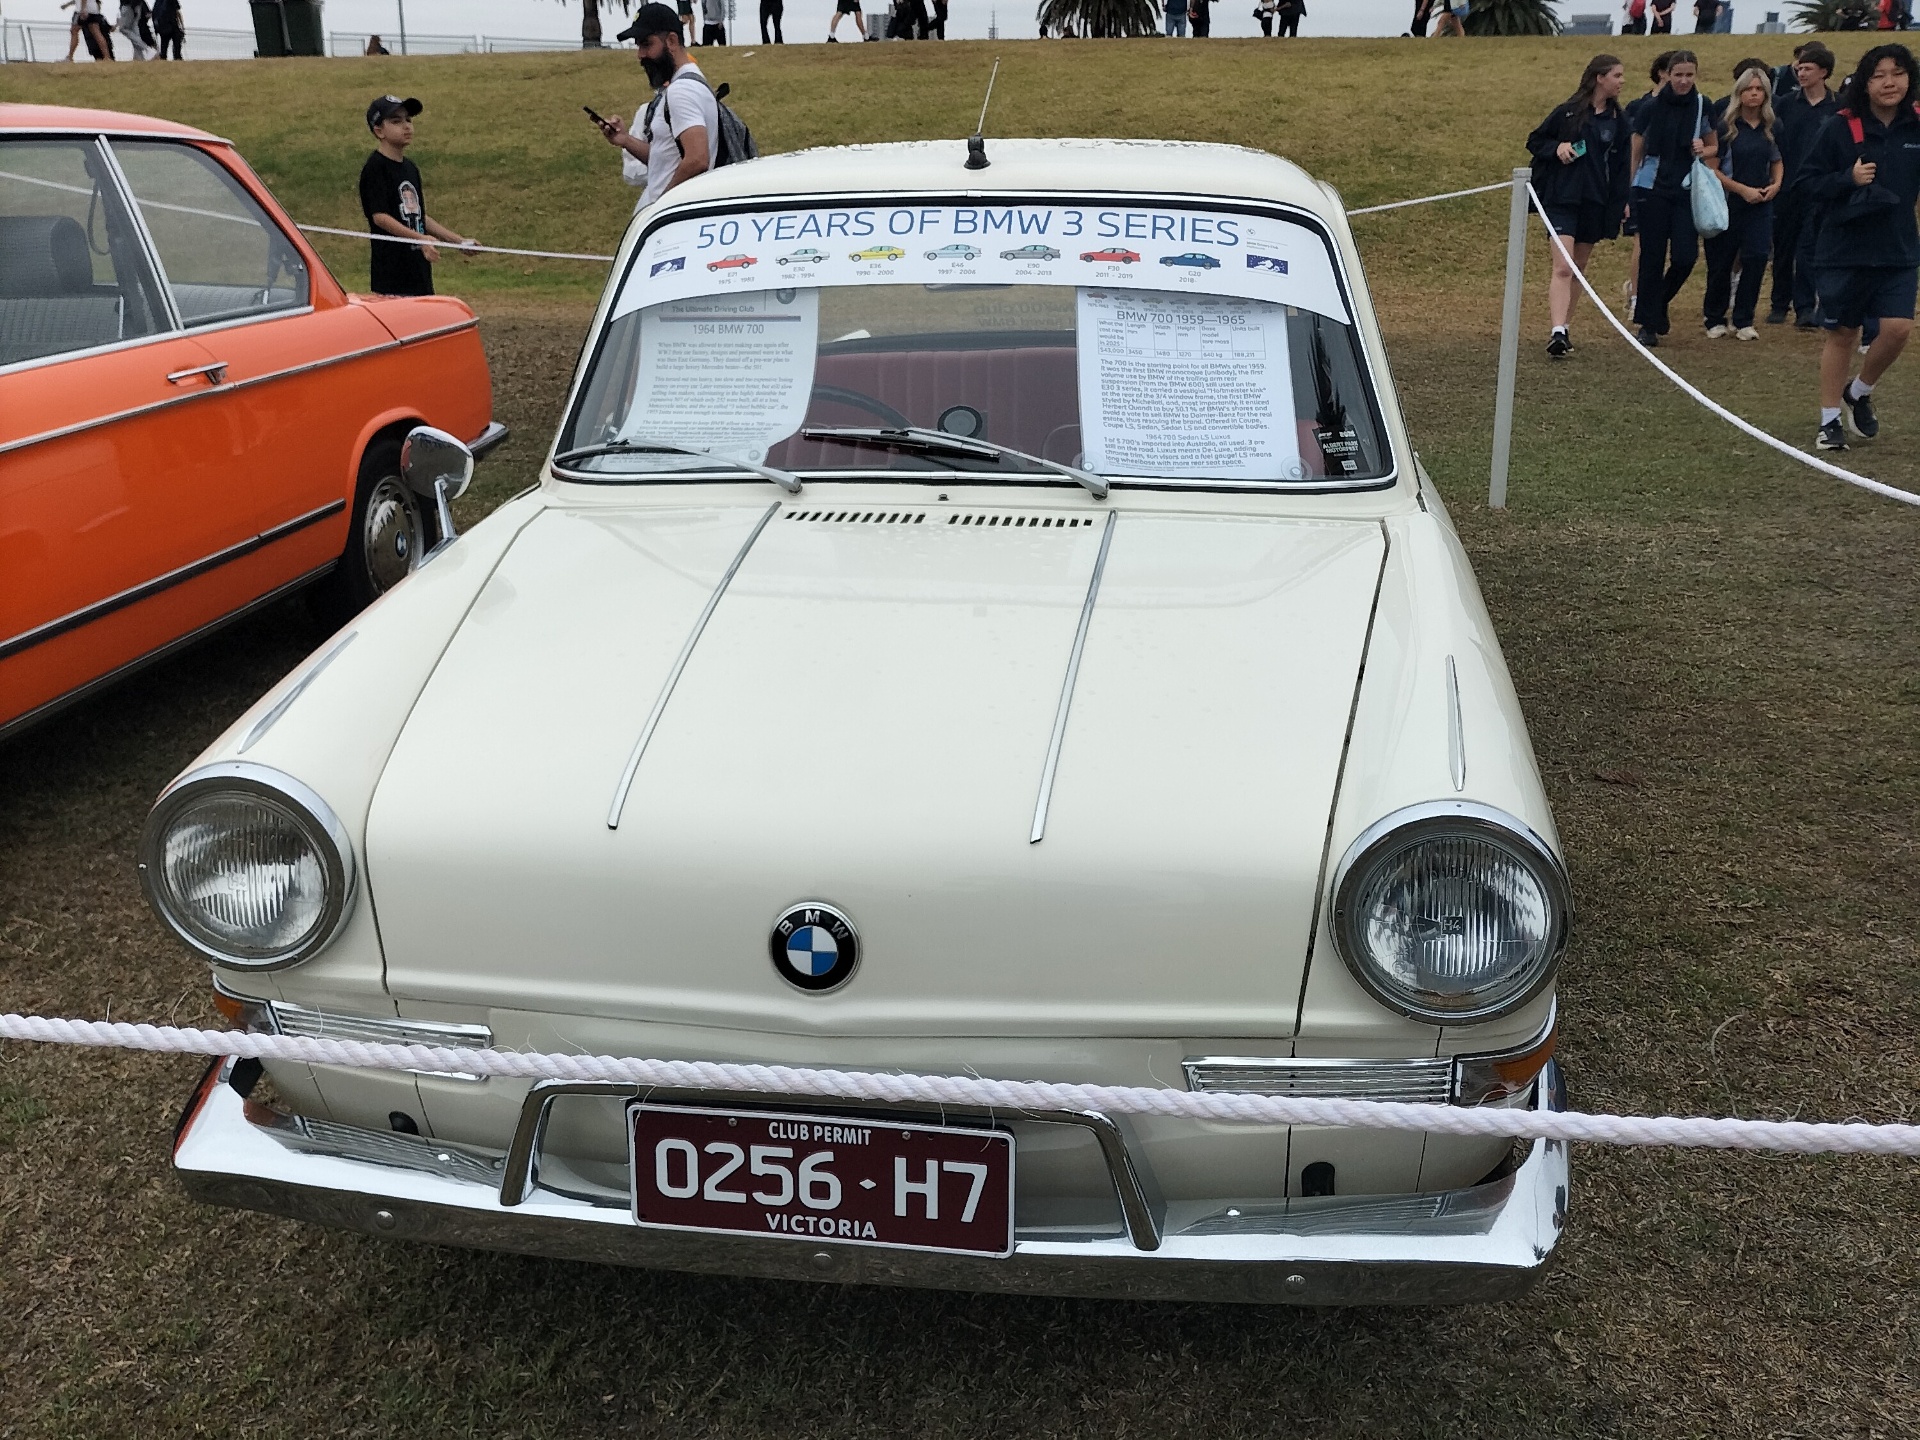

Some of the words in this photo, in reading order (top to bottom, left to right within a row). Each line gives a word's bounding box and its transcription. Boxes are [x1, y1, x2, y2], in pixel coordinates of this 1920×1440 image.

[697, 220, 740, 249] 50
[751, 210, 875, 242] YEARS
[888, 209, 942, 236] OF
[954, 208, 1053, 235] BMW
[1062, 210, 1084, 238] 3
[1097, 211, 1240, 247] SERIES
[672, 305, 684, 313] The
[685, 305, 713, 313] Ultimate
[714, 305, 738, 314] Driving
[739, 305, 755, 313] Club
[1116, 310, 1148, 321] BMW
[1150, 313, 1173, 324] 700
[693, 324, 715, 334] 1964
[718, 324, 745, 334] BMW
[746, 324, 764, 334] 700
[778, 909, 849, 940] BMW
[1443, 919, 1462, 931] H4
[768, 1121, 811, 1143] CLUB
[813, 1124, 872, 1147] PERMIT
[654, 1137, 843, 1212] 0256
[893, 1154, 989, 1224] H7
[765, 1211, 878, 1240] VICTORIA
